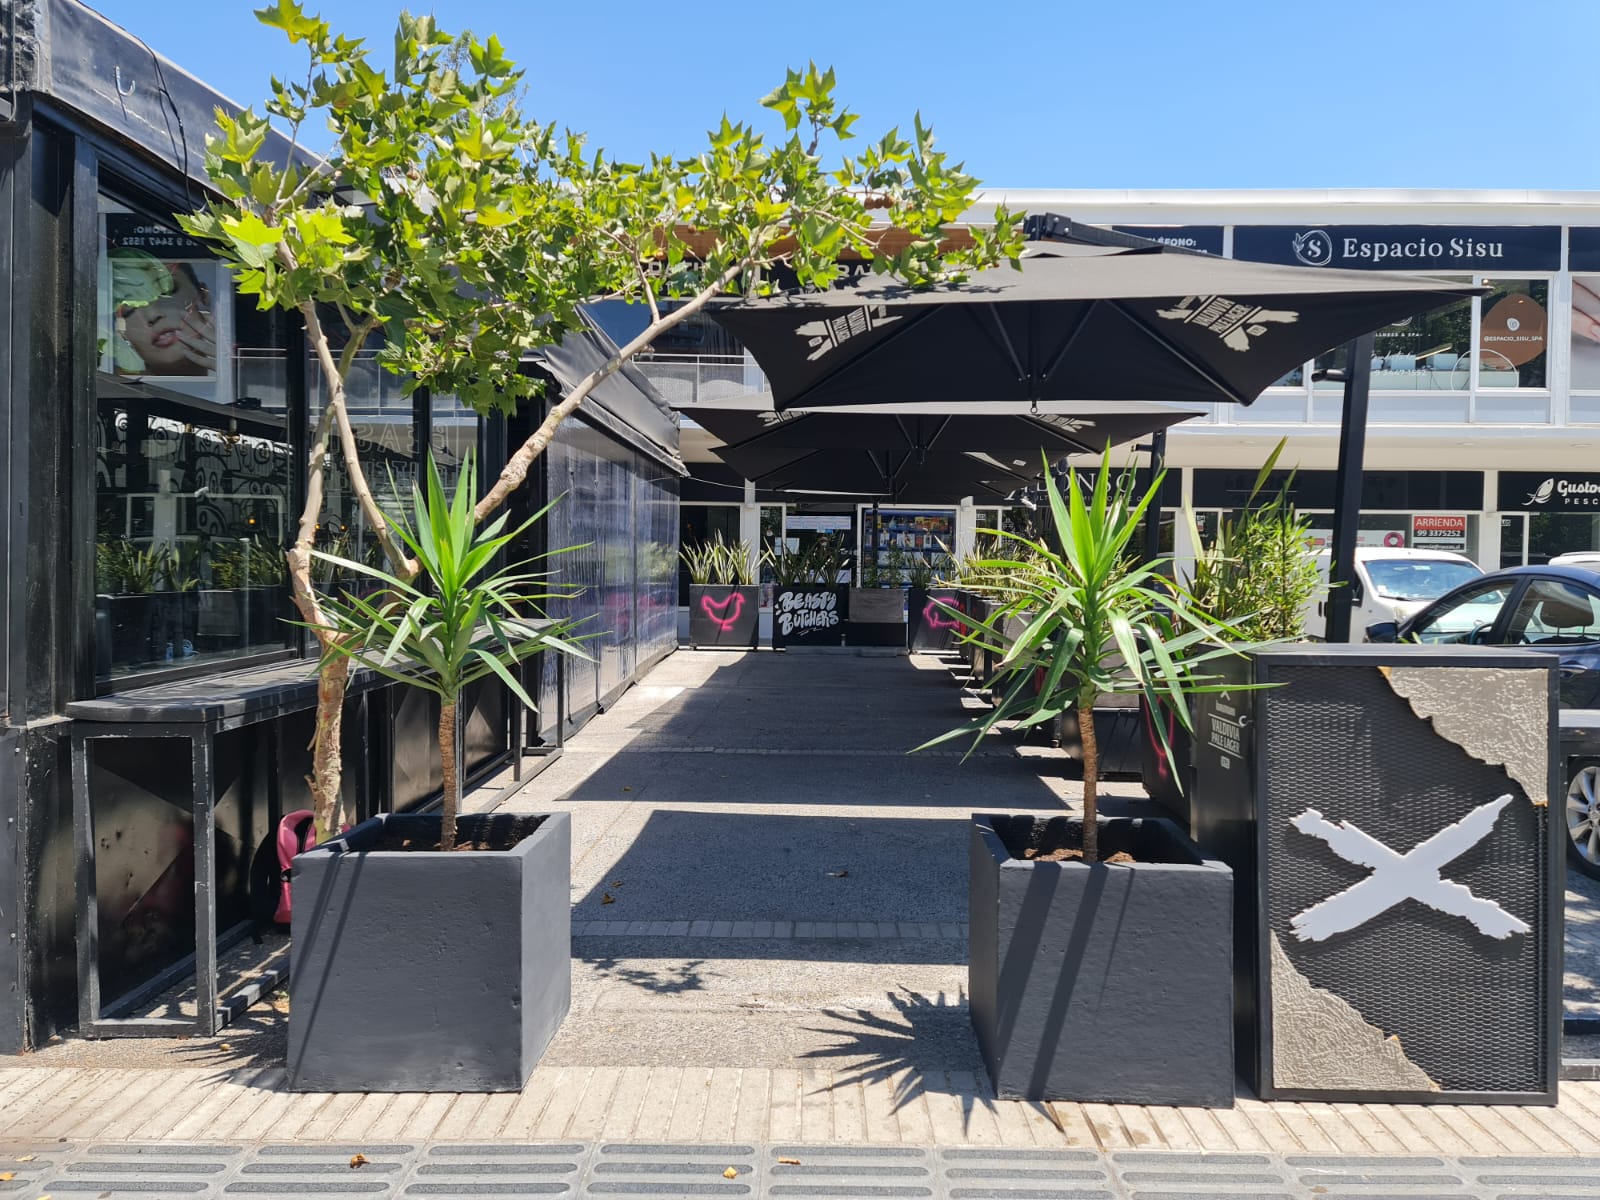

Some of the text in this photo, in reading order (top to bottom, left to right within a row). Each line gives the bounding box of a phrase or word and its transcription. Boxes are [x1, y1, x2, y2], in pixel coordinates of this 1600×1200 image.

[1342, 237, 1504, 262] Espacio Sisu
[1415, 518, 1464, 528] ARRIENDA
[1211, 718, 1240, 741] VALDIVIA
